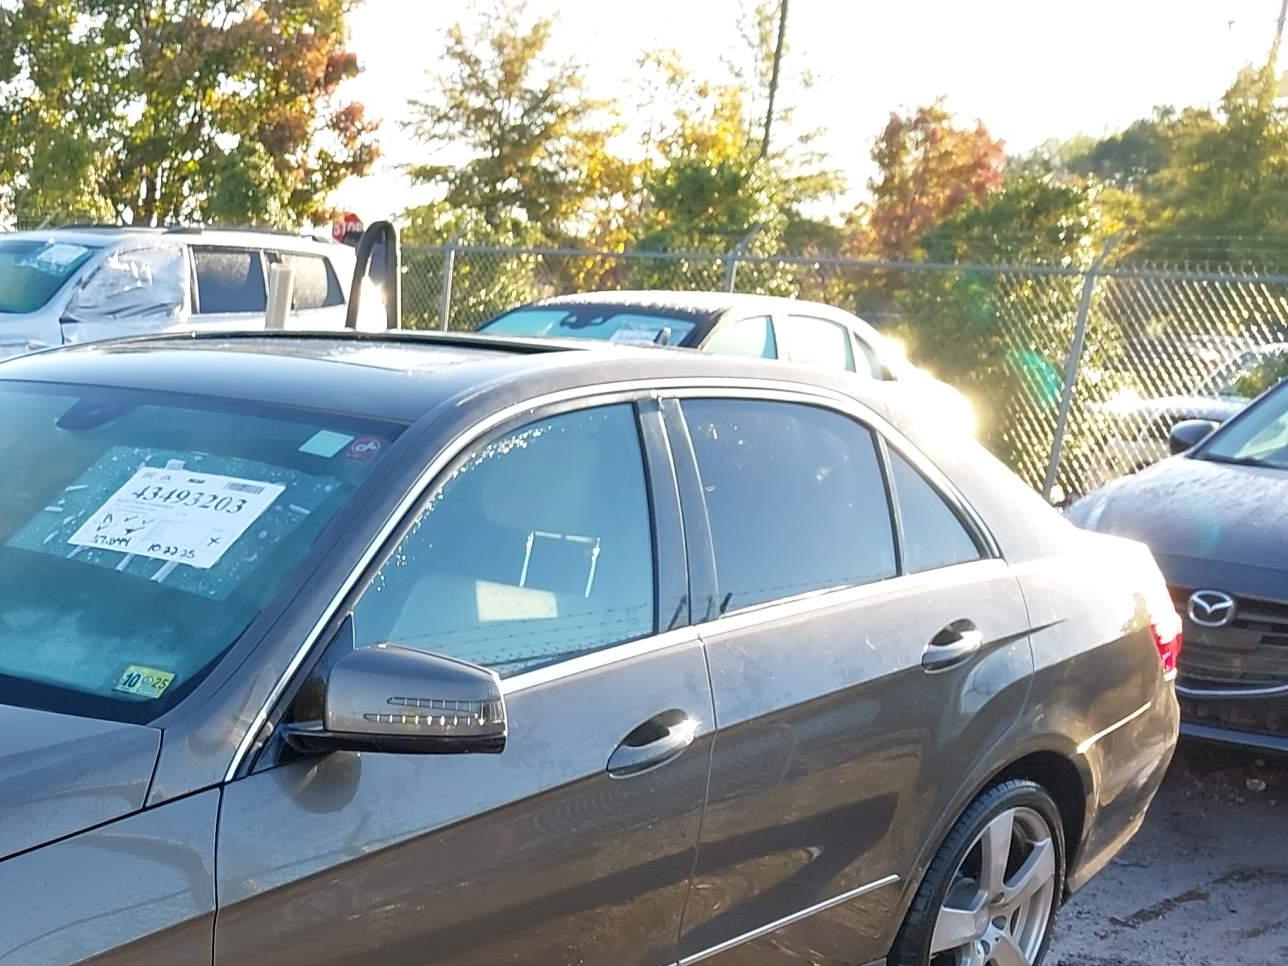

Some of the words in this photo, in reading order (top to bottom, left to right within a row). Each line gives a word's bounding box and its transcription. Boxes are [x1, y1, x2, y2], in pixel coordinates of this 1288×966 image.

[132, 484, 249, 514] 43493203
[122, 671, 142, 688] 10
[152, 677, 169, 689] 25
